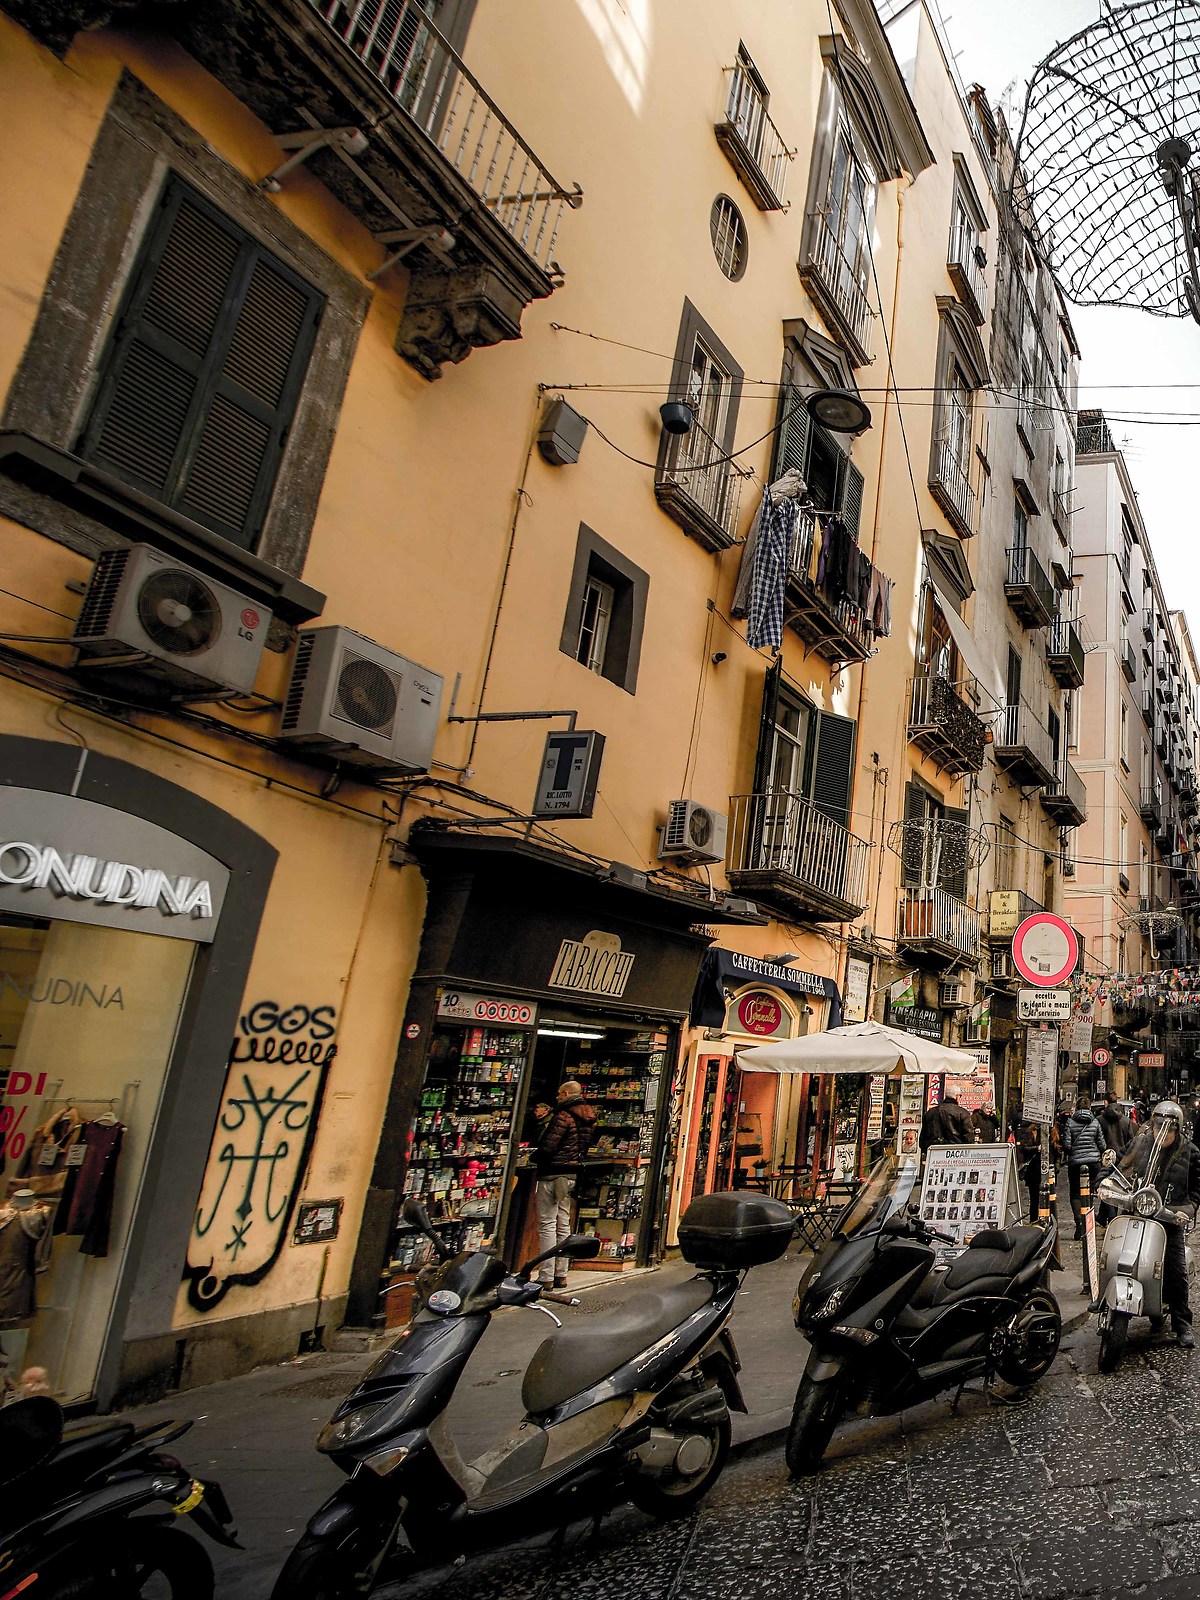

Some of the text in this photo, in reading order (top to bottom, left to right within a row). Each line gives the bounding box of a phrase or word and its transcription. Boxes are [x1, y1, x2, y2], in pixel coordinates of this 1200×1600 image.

[238, 627, 254, 642] LG
[549, 737, 588, 790] T
[554, 801, 571, 809] 1794
[0, 841, 213, 918] ONUDINA
[553, 942, 634, 995] TABACCHI
[732, 953, 824, 989] CAFFETTERIA SOMMELLA
[799, 984, 811, 993] DAL
[443, 995, 459, 1006] 10
[475, 1000, 531, 1022] LOTTO
[1140, 1057, 1162, 1065] OUTLET
